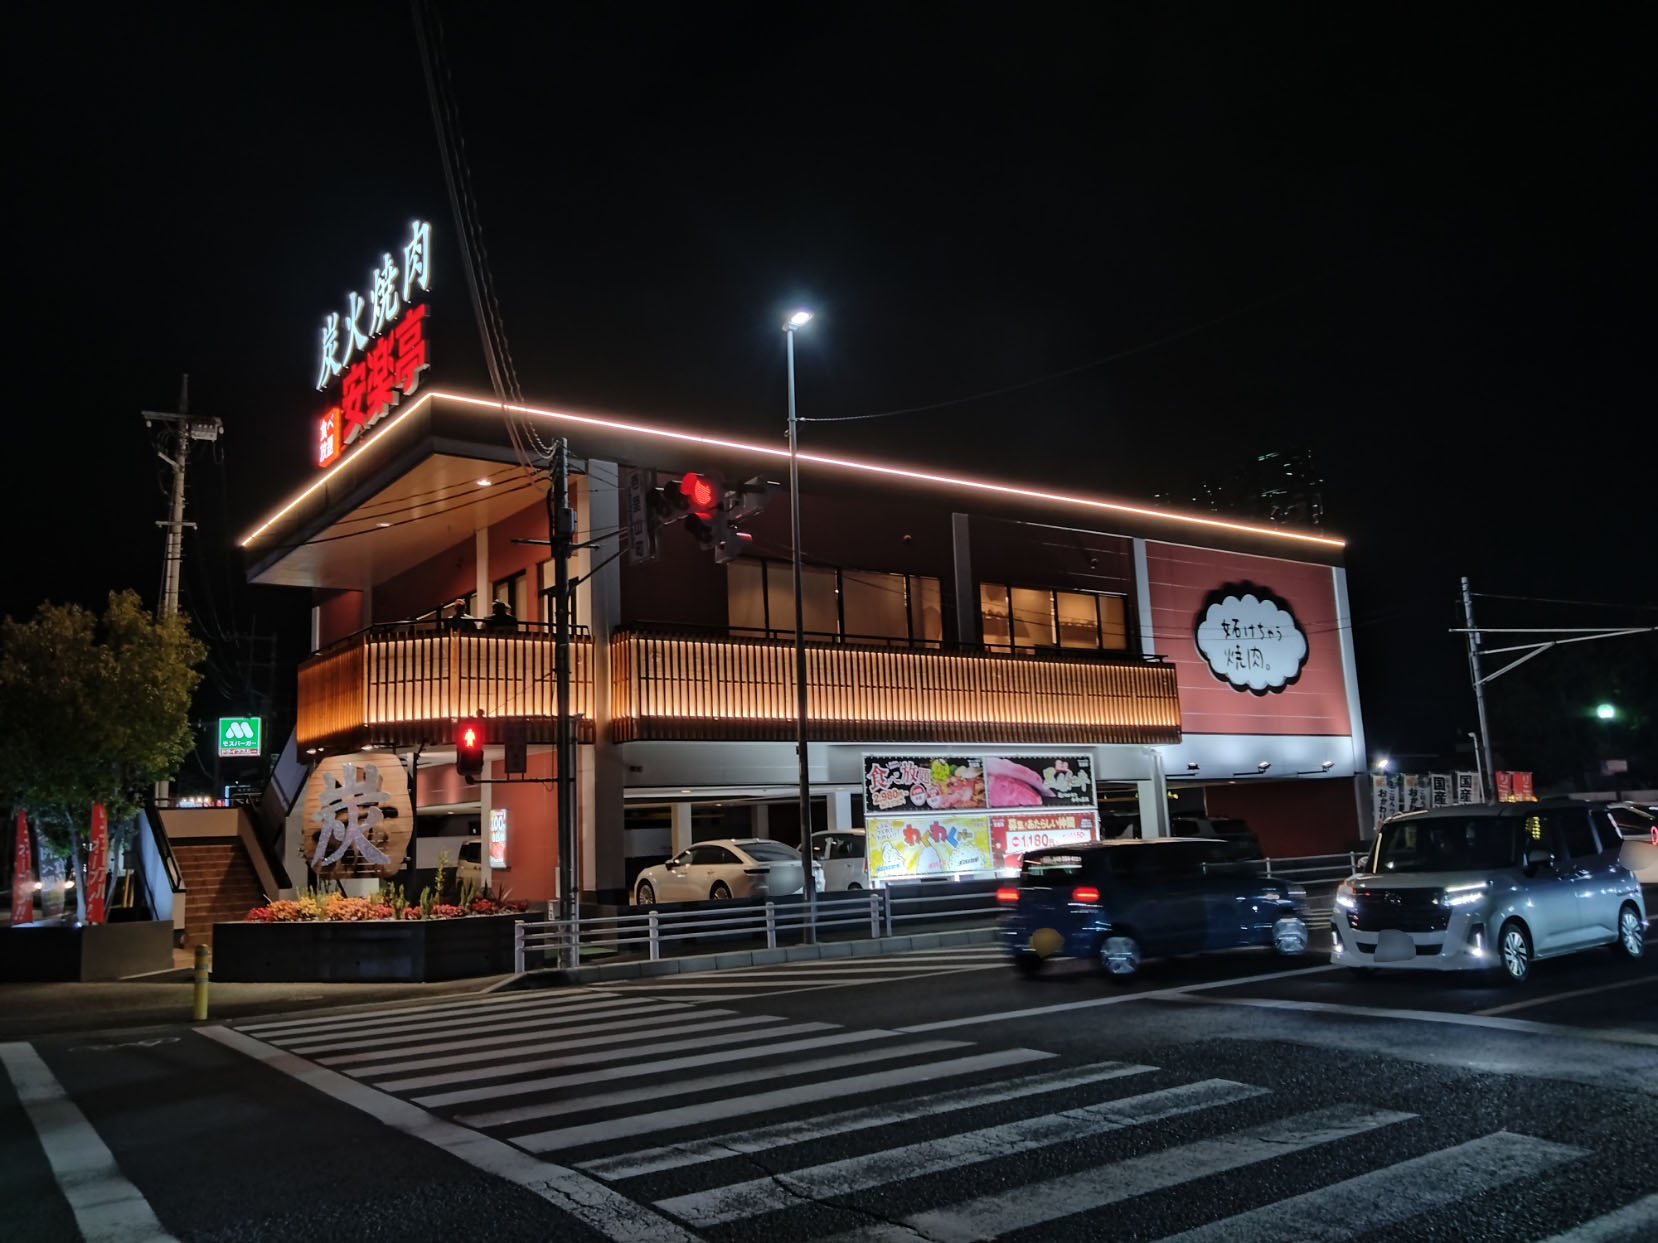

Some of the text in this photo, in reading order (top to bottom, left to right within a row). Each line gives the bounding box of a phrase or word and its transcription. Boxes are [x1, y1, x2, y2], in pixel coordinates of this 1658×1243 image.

[315, 220, 432, 392] 炭火焼肉
[341, 304, 428, 444] 安楽亭
[311, 762, 391, 867] 炭
[1433, 776, 1447, 808] 国産
[1459, 774, 1472, 805] 国産
